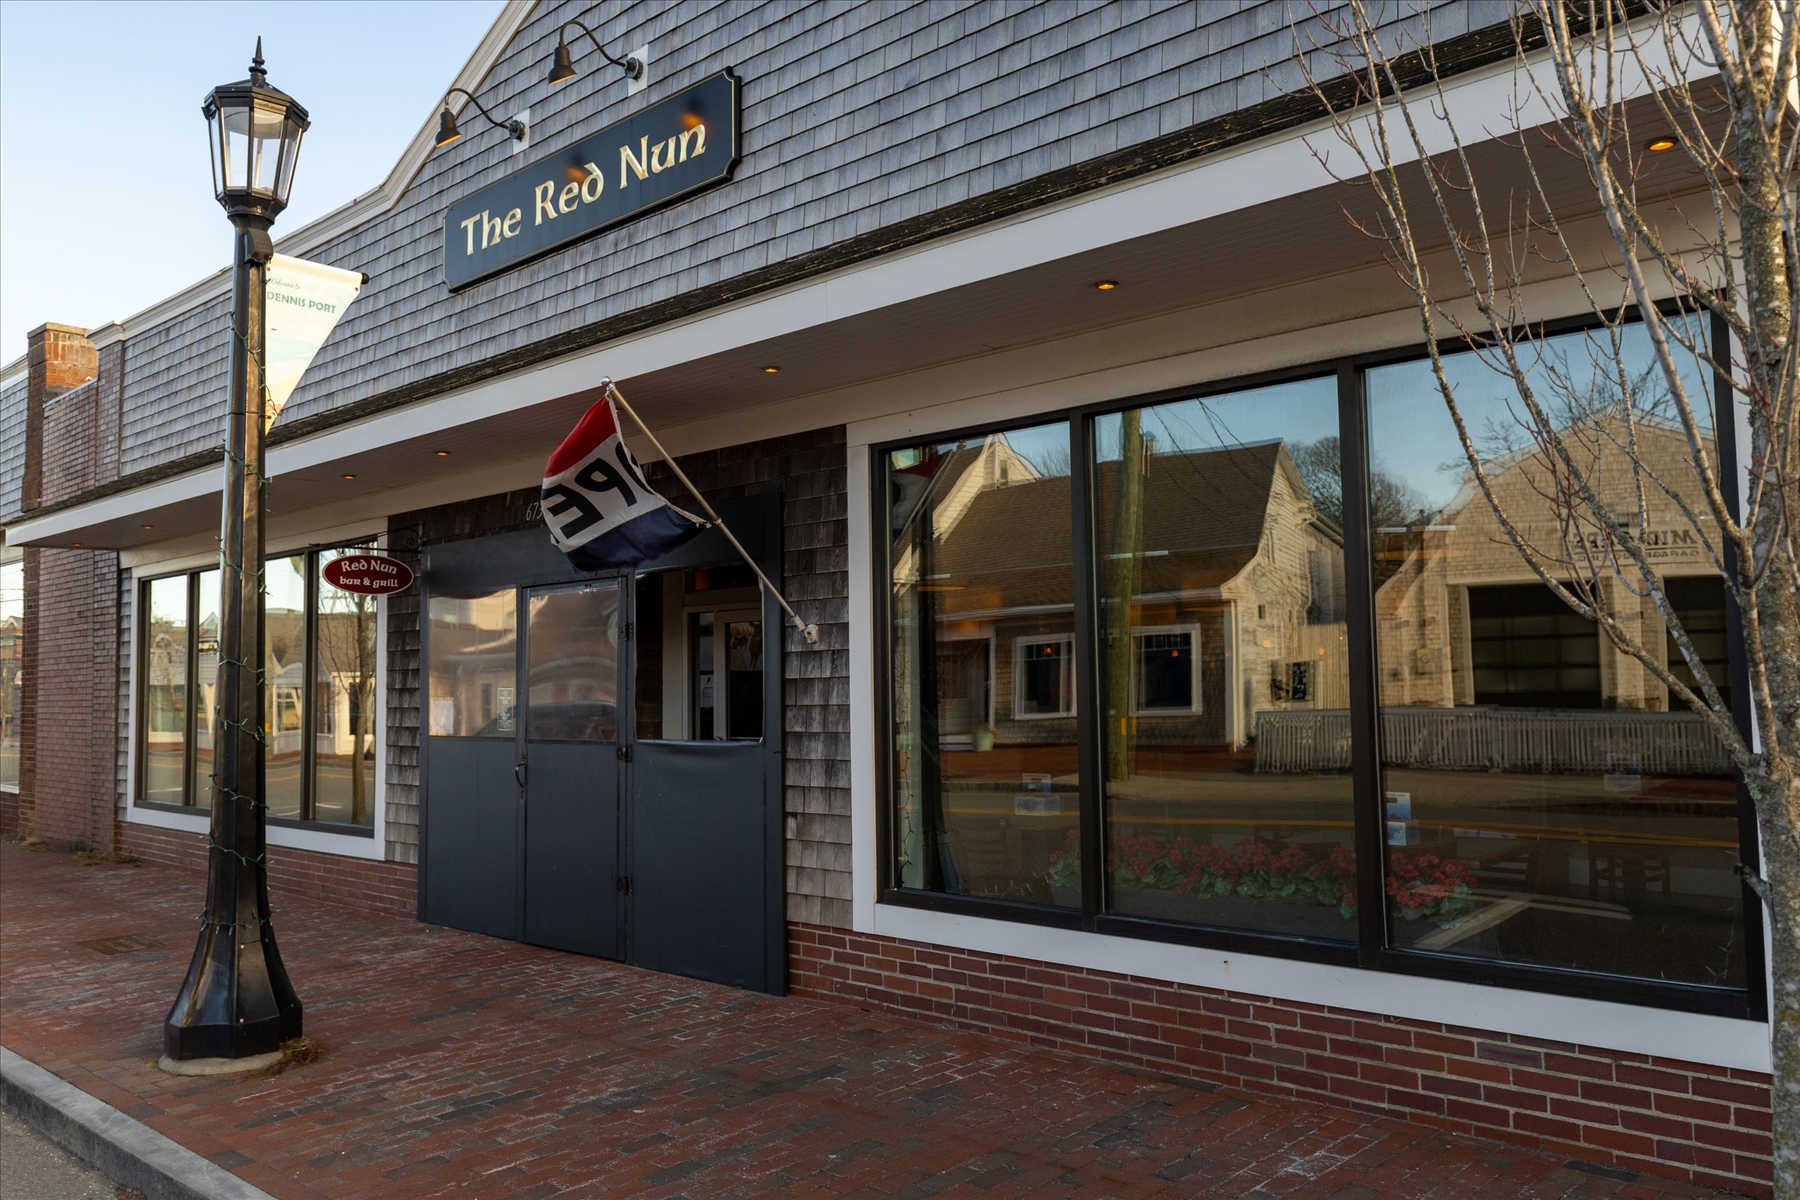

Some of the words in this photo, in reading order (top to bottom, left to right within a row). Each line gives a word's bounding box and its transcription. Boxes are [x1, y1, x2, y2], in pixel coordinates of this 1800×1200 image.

[460, 207, 522, 256] The
[534, 162, 605, 226] Red
[619, 124, 707, 190] Nun
[267, 291, 306, 307] DENNIS
[308, 300, 337, 314] PORT
[341, 559, 368, 572] Red
[370, 559, 397, 575] Nun
[339, 576, 361, 585] bar
[363, 577, 371, 586] &
[373, 579, 398, 588] grill
